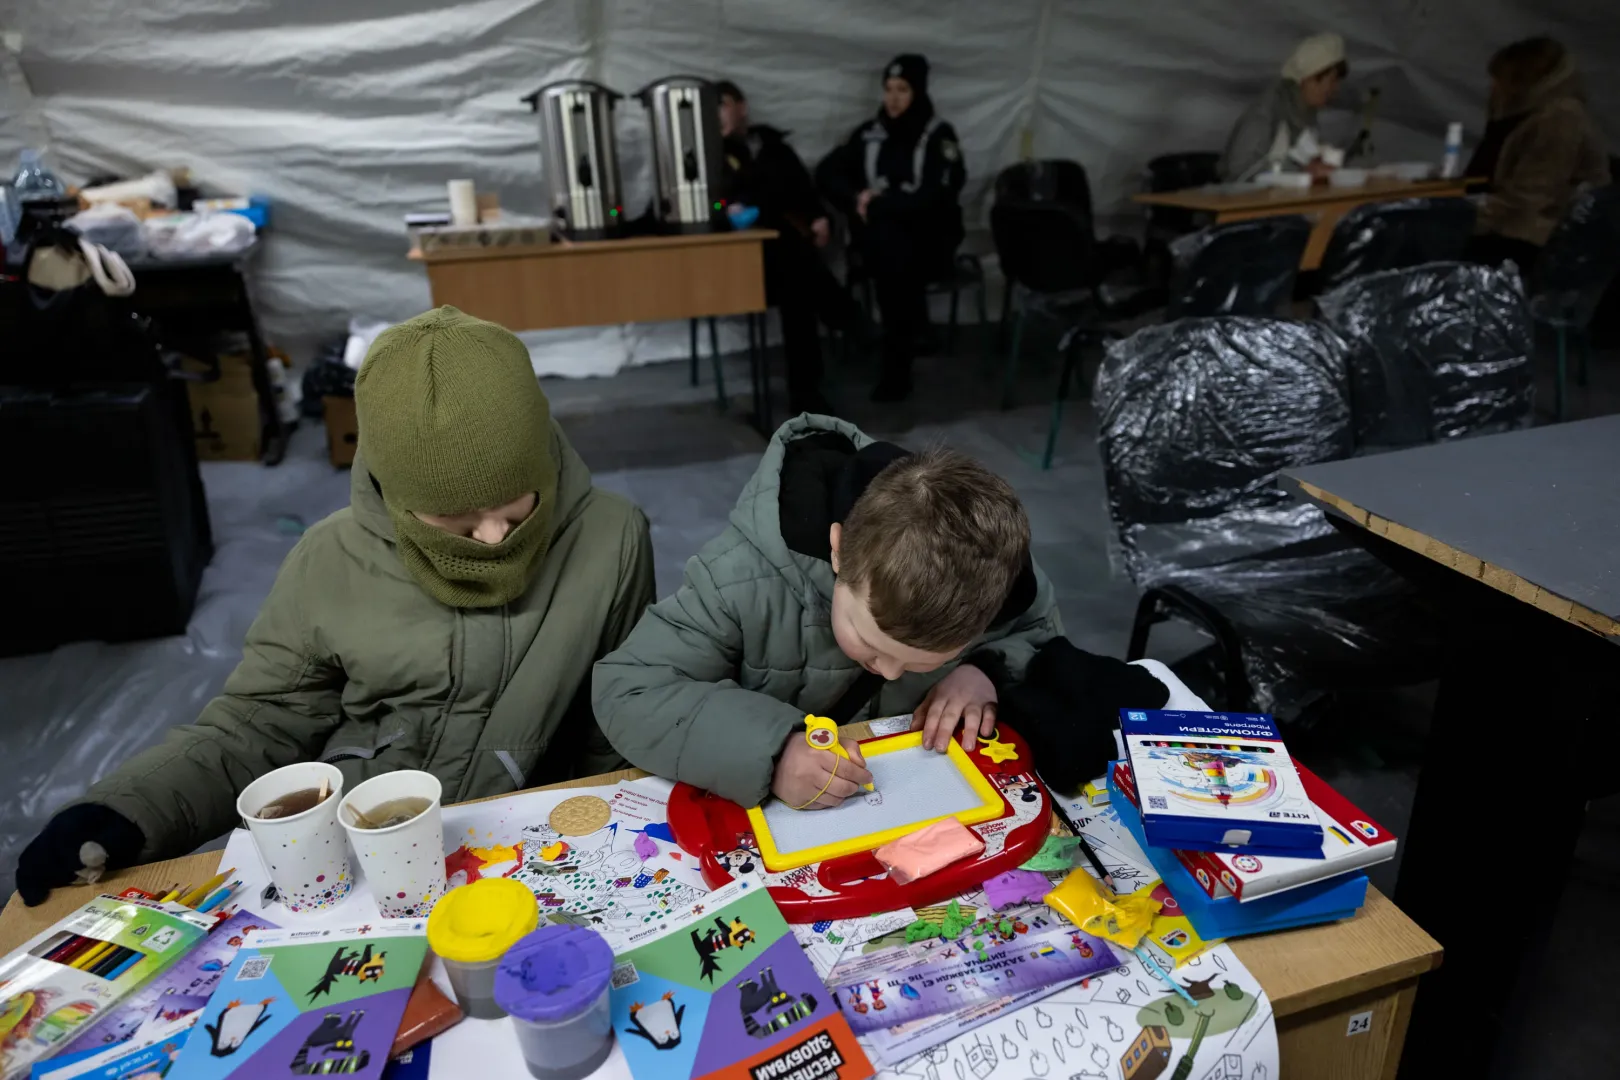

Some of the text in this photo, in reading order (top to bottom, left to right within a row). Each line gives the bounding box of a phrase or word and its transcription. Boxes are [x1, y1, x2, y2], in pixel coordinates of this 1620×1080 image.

[1130, 712, 1147, 721] 12
[1179, 726, 1274, 737] ФЛОМАСТЕРИ
[1224, 722, 1271, 730] Fiberpens
[1282, 812, 1310, 820] KITE
[979, 957, 1026, 973] ЗАХИСТ
[935, 968, 978, 985] ЗАВЖДИ
[1349, 1017, 1369, 1032] 24
[755, 1034, 832, 1080] ЗДОБУВАЙ
